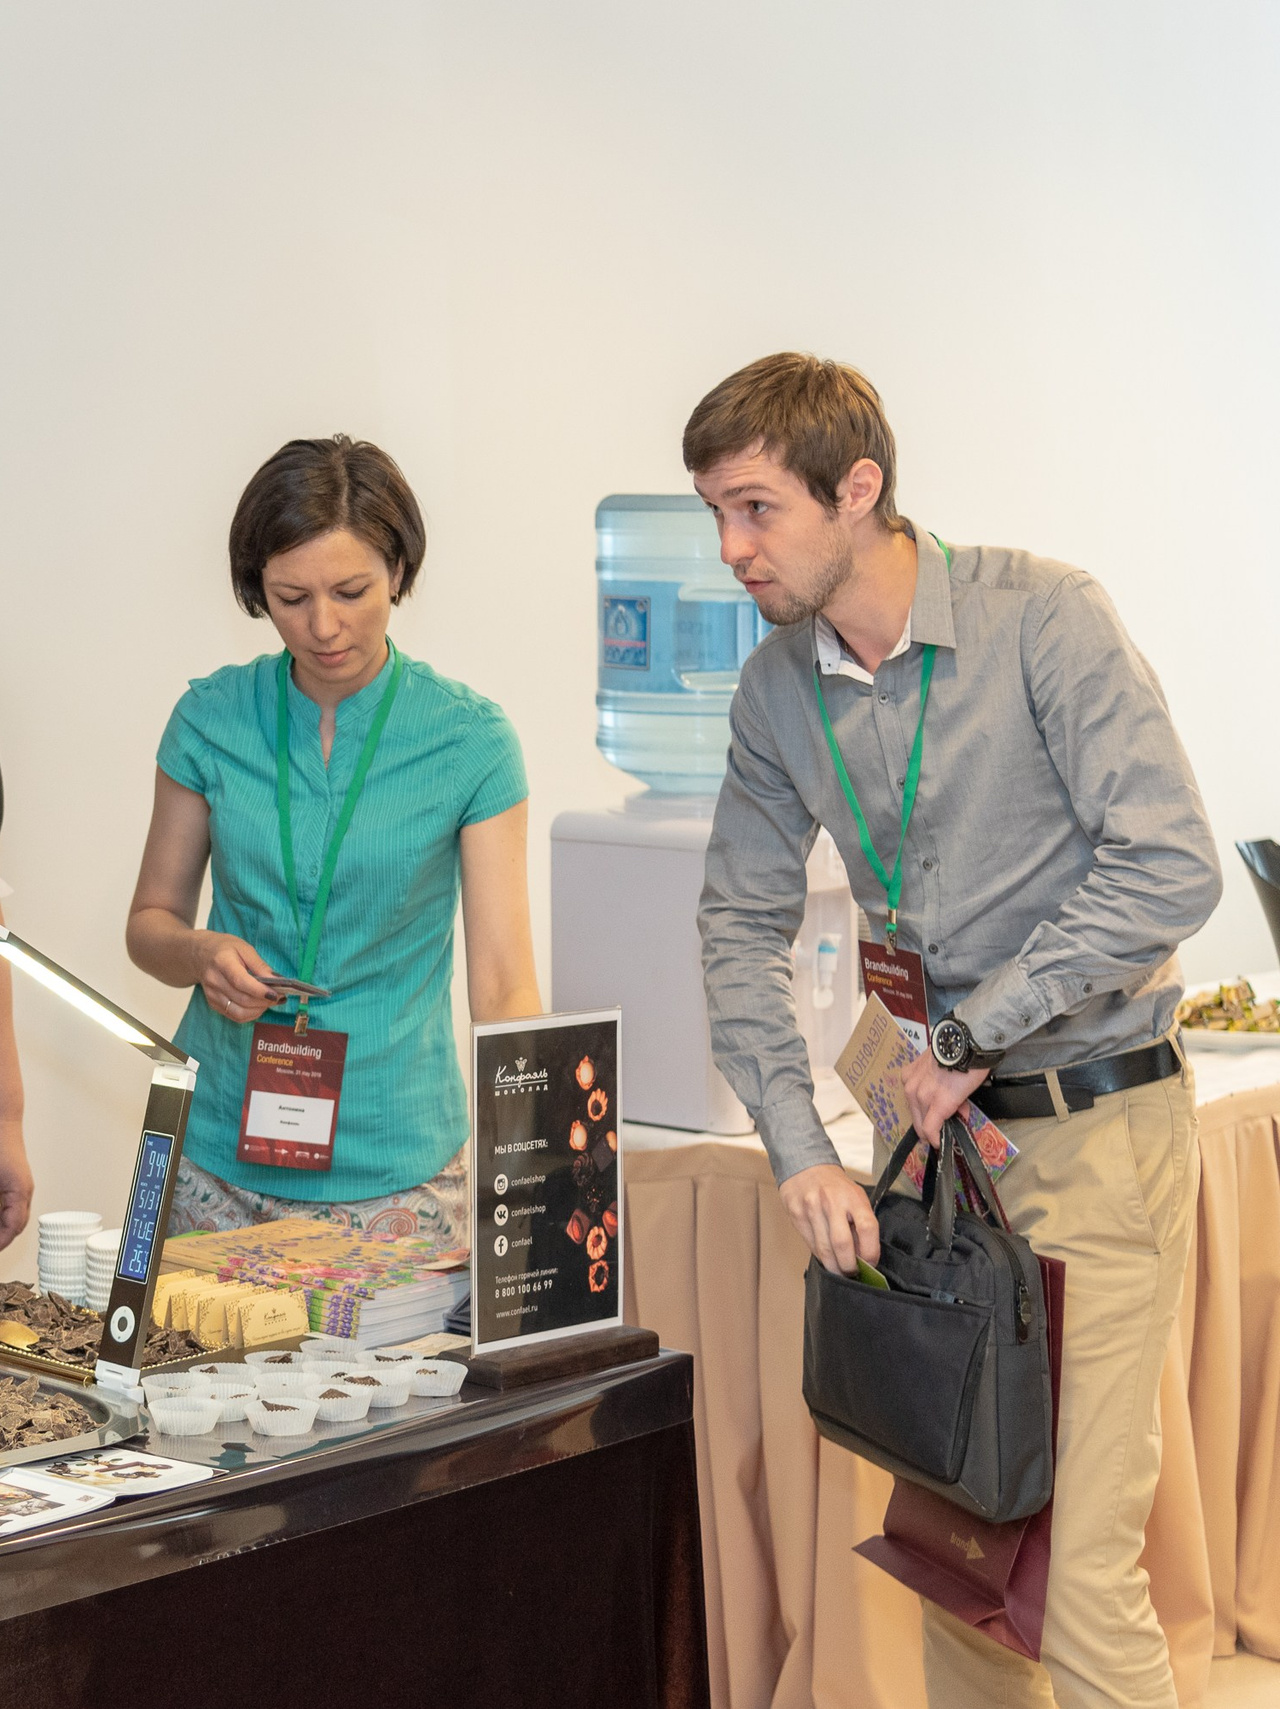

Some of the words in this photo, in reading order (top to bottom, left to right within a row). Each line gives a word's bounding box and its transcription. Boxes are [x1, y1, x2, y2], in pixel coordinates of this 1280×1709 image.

[864, 957, 909, 982] Brandbuilding
[866, 972, 893, 987] Conference
[257, 1039, 322, 1060] Brandbuilding
[845, 1013, 889, 1088] КОНФАЭЛЬ
[256, 1054, 294, 1066] Conference
[494, 1065, 548, 1088] Конфаэль
[494, 1084, 548, 1096] ШОКОЛАД
[494, 1145, 507, 1155] МЫ
[508, 1143, 512, 1153] В
[513, 1139, 548, 1152] СОЦСЕТЯХ:
[511, 1174, 546, 1187] confaelshop
[511, 1204, 546, 1217] confaelshop
[132, 1218, 154, 1241] TUE
[511, 1236, 533, 1248] confael
[495, 1289, 500, 1299] 8
[502, 1286, 515, 1297] 800
[518, 1283, 531, 1294] 100
[532, 1281, 541, 1292] 66
[543, 1279, 553, 1290] 99
[495, 1304, 539, 1318] www.confael.ru
